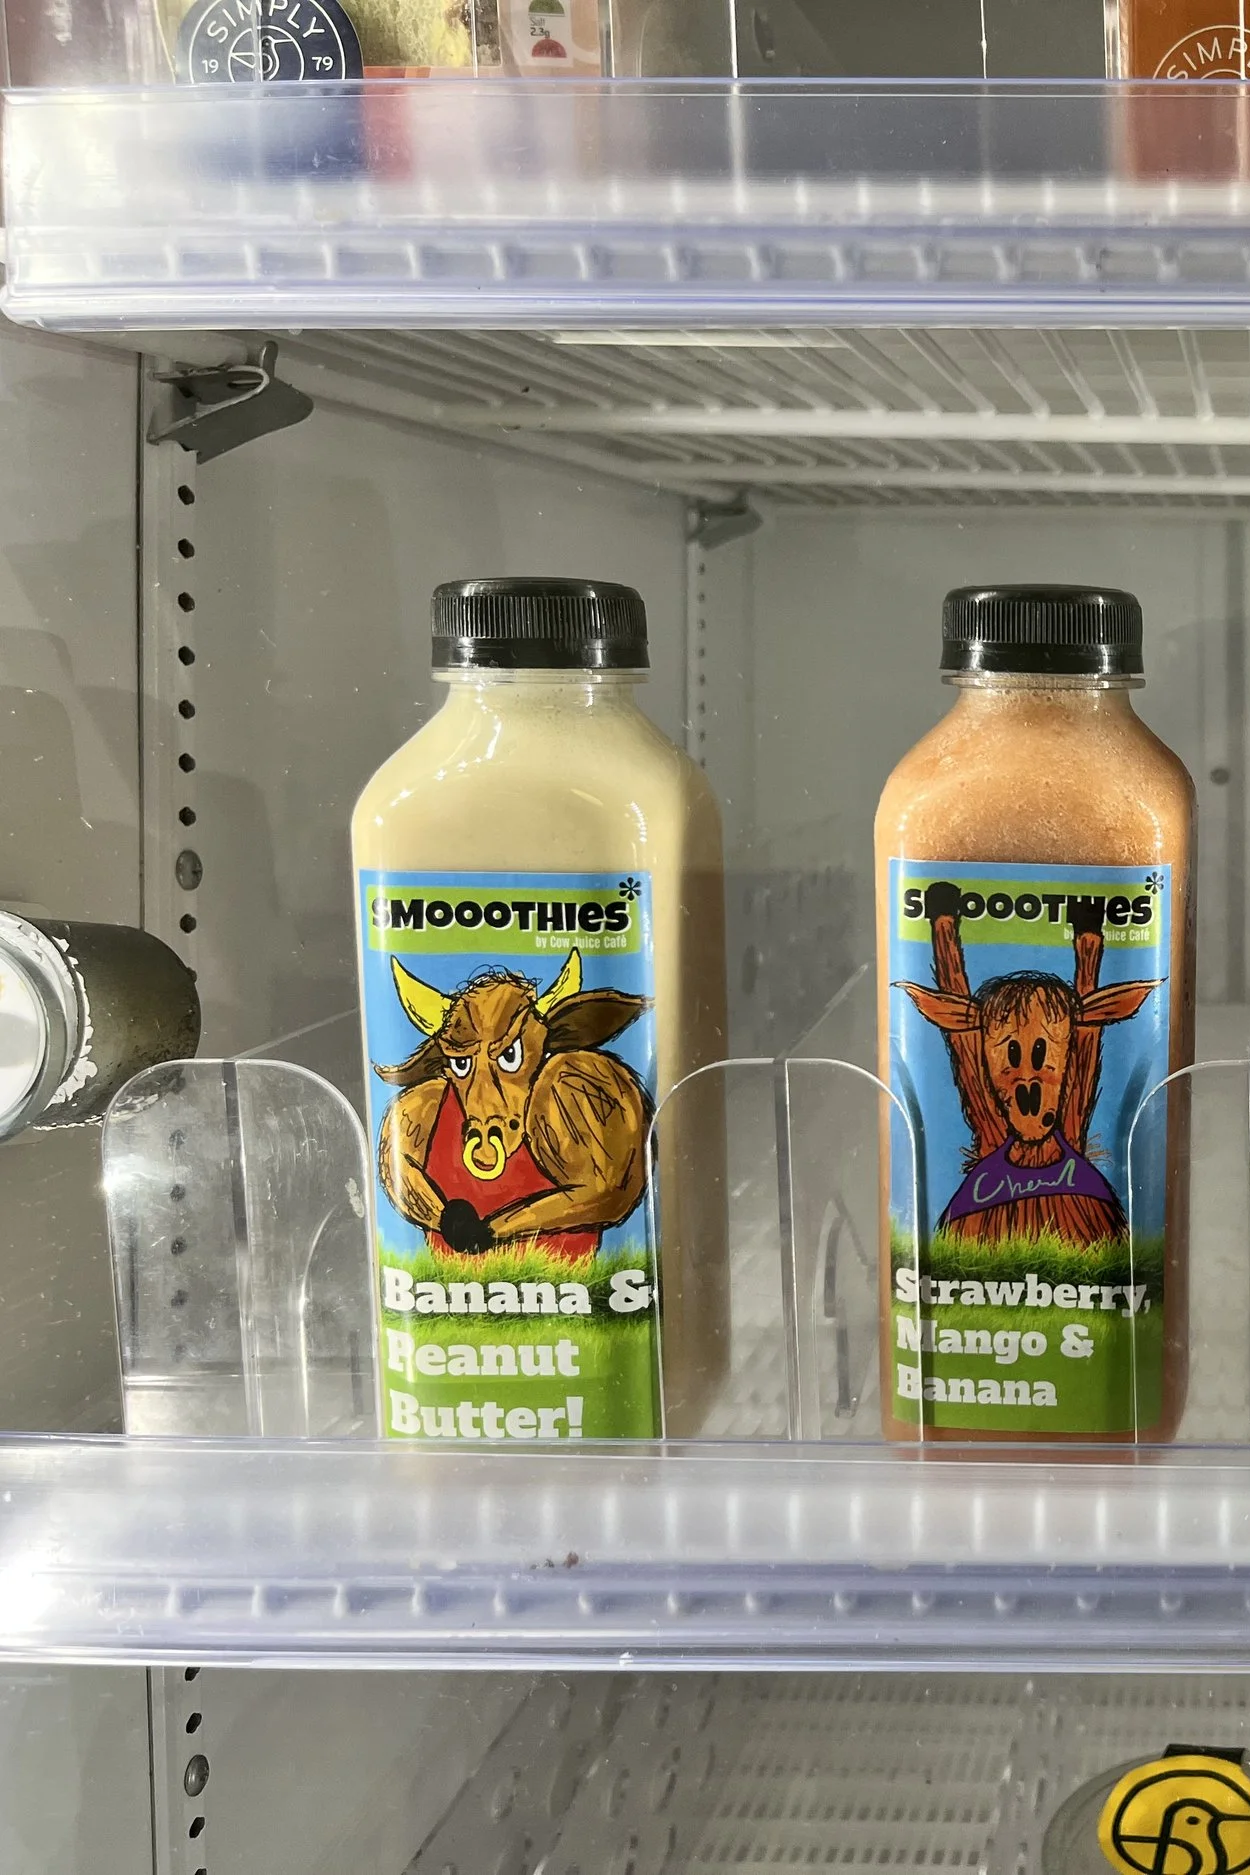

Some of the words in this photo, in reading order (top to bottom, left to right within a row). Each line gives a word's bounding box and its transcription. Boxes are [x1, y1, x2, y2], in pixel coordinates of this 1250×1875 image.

[207, 0, 325, 43] SIMPLY
[201, 59, 219, 74] 19
[312, 56, 333, 71] 79
[535, 936, 547, 948] by
[550, 935, 570, 948] Cow
[573, 936, 600, 948] Juice
[1102, 929, 1126, 941] uice
[382, 1266, 592, 1314] Banana
[609, 1269, 657, 1313] &
[895, 1267, 1150, 1317] Strawberry,
[386, 1329, 580, 1381] Peanut
[896, 1315, 1048, 1365] Mango
[1060, 1323, 1095, 1358] &
[896, 1363, 1058, 1406] Banana
[389, 1389, 584, 1438] Butter!
